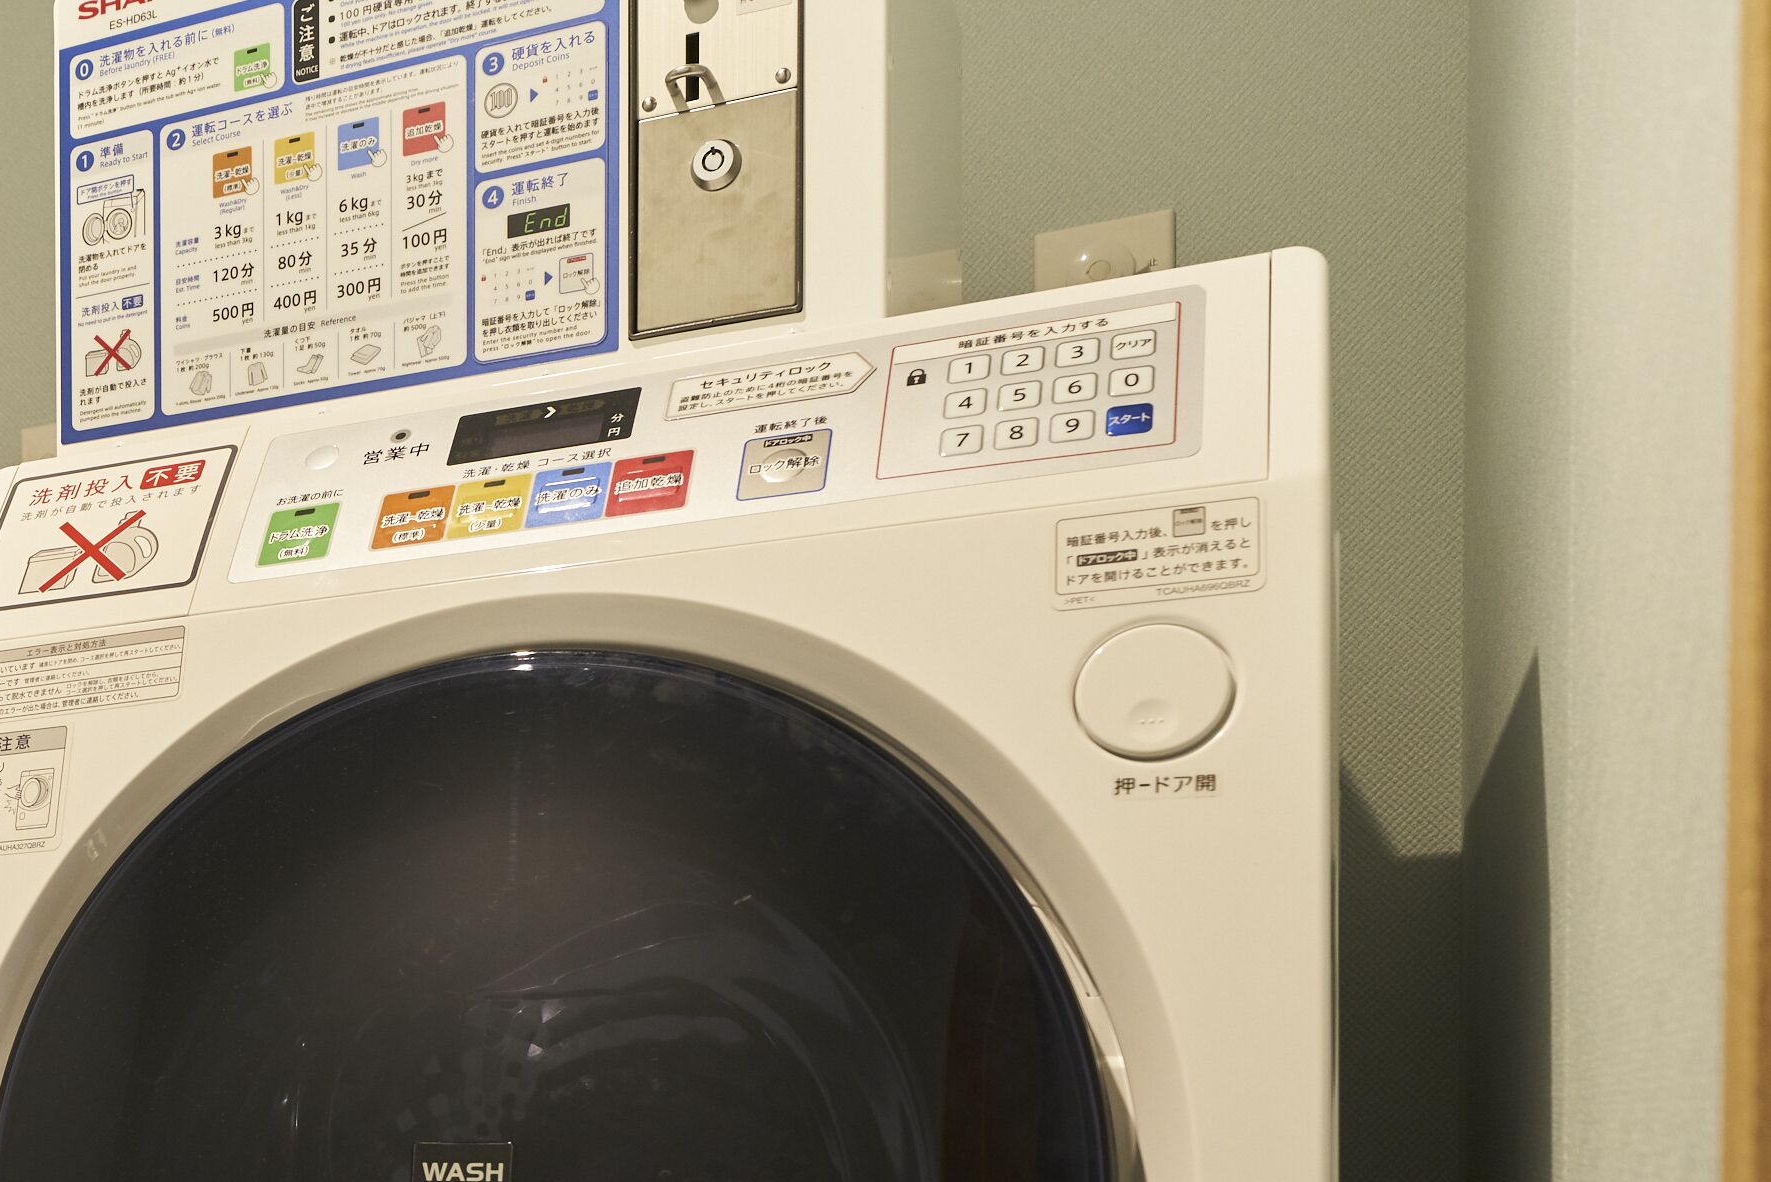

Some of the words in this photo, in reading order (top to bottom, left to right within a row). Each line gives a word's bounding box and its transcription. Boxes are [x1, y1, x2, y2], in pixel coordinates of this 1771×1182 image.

[109, 11, 158, 30] ES-HD63L
[298, 3, 316, 63] ご注意
[99, 29, 209, 68] 洗濯物を入れる前に
[511, 30, 596, 61] 硬貨を入れる
[80, 63, 89, 77] 0
[99, 65, 122, 77] Before
[124, 57, 151, 72] laundry
[152, 50, 175, 66] (FREE)
[235, 60, 269, 74] ドラム洗浄
[295, 65, 319, 77] NOTICE
[488, 56, 499, 72] 3
[512, 58, 544, 72] Deposit
[546, 52, 570, 64] Coins
[191, 101, 293, 138] 運転コースを選ぶ
[191, 134, 214, 148] Select
[215, 129, 242, 143] Course
[405, 122, 443, 138] 追加乾燥
[99, 142, 124, 159] 準備
[339, 135, 376, 152] 洗濯のみ
[99, 157, 121, 170] Ready
[123, 156, 130, 164] to
[131, 151, 148, 162] Start
[410, 157, 423, 168] Dry
[424, 155, 439, 164] more
[350, 170, 367, 180] Wash
[426, 169, 444, 181] まで
[511, 172, 569, 197] 運転終了
[487, 190, 499, 205] 4
[512, 194, 537, 208] Finish
[428, 205, 443, 215] min
[524, 207, 568, 234] End
[175, 245, 198, 257] Capacity
[434, 242, 448, 253] yen
[78, 263, 99, 274] 閉める
[562, 268, 591, 279] ロック解除
[186, 282, 201, 292] Time
[400, 279, 415, 289] Press
[428, 273, 450, 284] button
[81, 301, 120, 318] 洗剤投入
[175, 315, 188, 324] 料金
[175, 322, 191, 331] Coins
[263, 320, 317, 339] 洗濯量の目安
[320, 313, 357, 328] Reference
[349, 326, 367, 335] タオル
[482, 336, 500, 346] Enter
[512, 330, 538, 341] security
[538, 327, 565, 337] number
[565, 324, 578, 332] and
[958, 318, 1110, 350] 暗証番号を入力する
[964, 361, 973, 375] 1
[1016, 353, 1029, 367] 2
[1070, 345, 1084, 359] 3
[1115, 338, 1153, 351] クリア
[700, 361, 832, 389] セキュリティロック
[79, 378, 148, 398] 洗剤が自動で投入さ
[958, 396, 973, 409] 4
[1012, 387, 1026, 402] 5
[1068, 380, 1082, 394] 6
[1124, 372, 1140, 387] 0
[79, 394, 102, 407] れます
[610, 412, 625, 424] 分
[754, 415, 829, 434] 運転終了後
[607, 426, 621, 439] 円
[956, 432, 970, 448] 7
[1009, 425, 1024, 440] 8
[1065, 418, 1080, 433] 9
[1109, 412, 1152, 427] スタート
[763, 434, 813, 448] ドアロック中
[363, 442, 431, 466] 営業中
[537, 447, 612, 467] コース選択
[748, 455, 820, 475] ロック解除
[28, 473, 134, 508] 洗剤投入
[144, 461, 201, 488] 不要
[614, 473, 684, 495] 追加乾燥
[19, 484, 202, 522] 洗剤が自動で投入されます
[275, 487, 345, 507] お洗濯の前に
[535, 484, 602, 505] 洗濯のみ
[1210, 517, 1252, 531] を押し
[268, 524, 329, 545] ドラム洗浄
[1066, 557, 1249, 587] ドアを開けることができます。
[26, 638, 107, 658] エラー表示と対処方法
[422, 1162, 504, 1182] WASH
